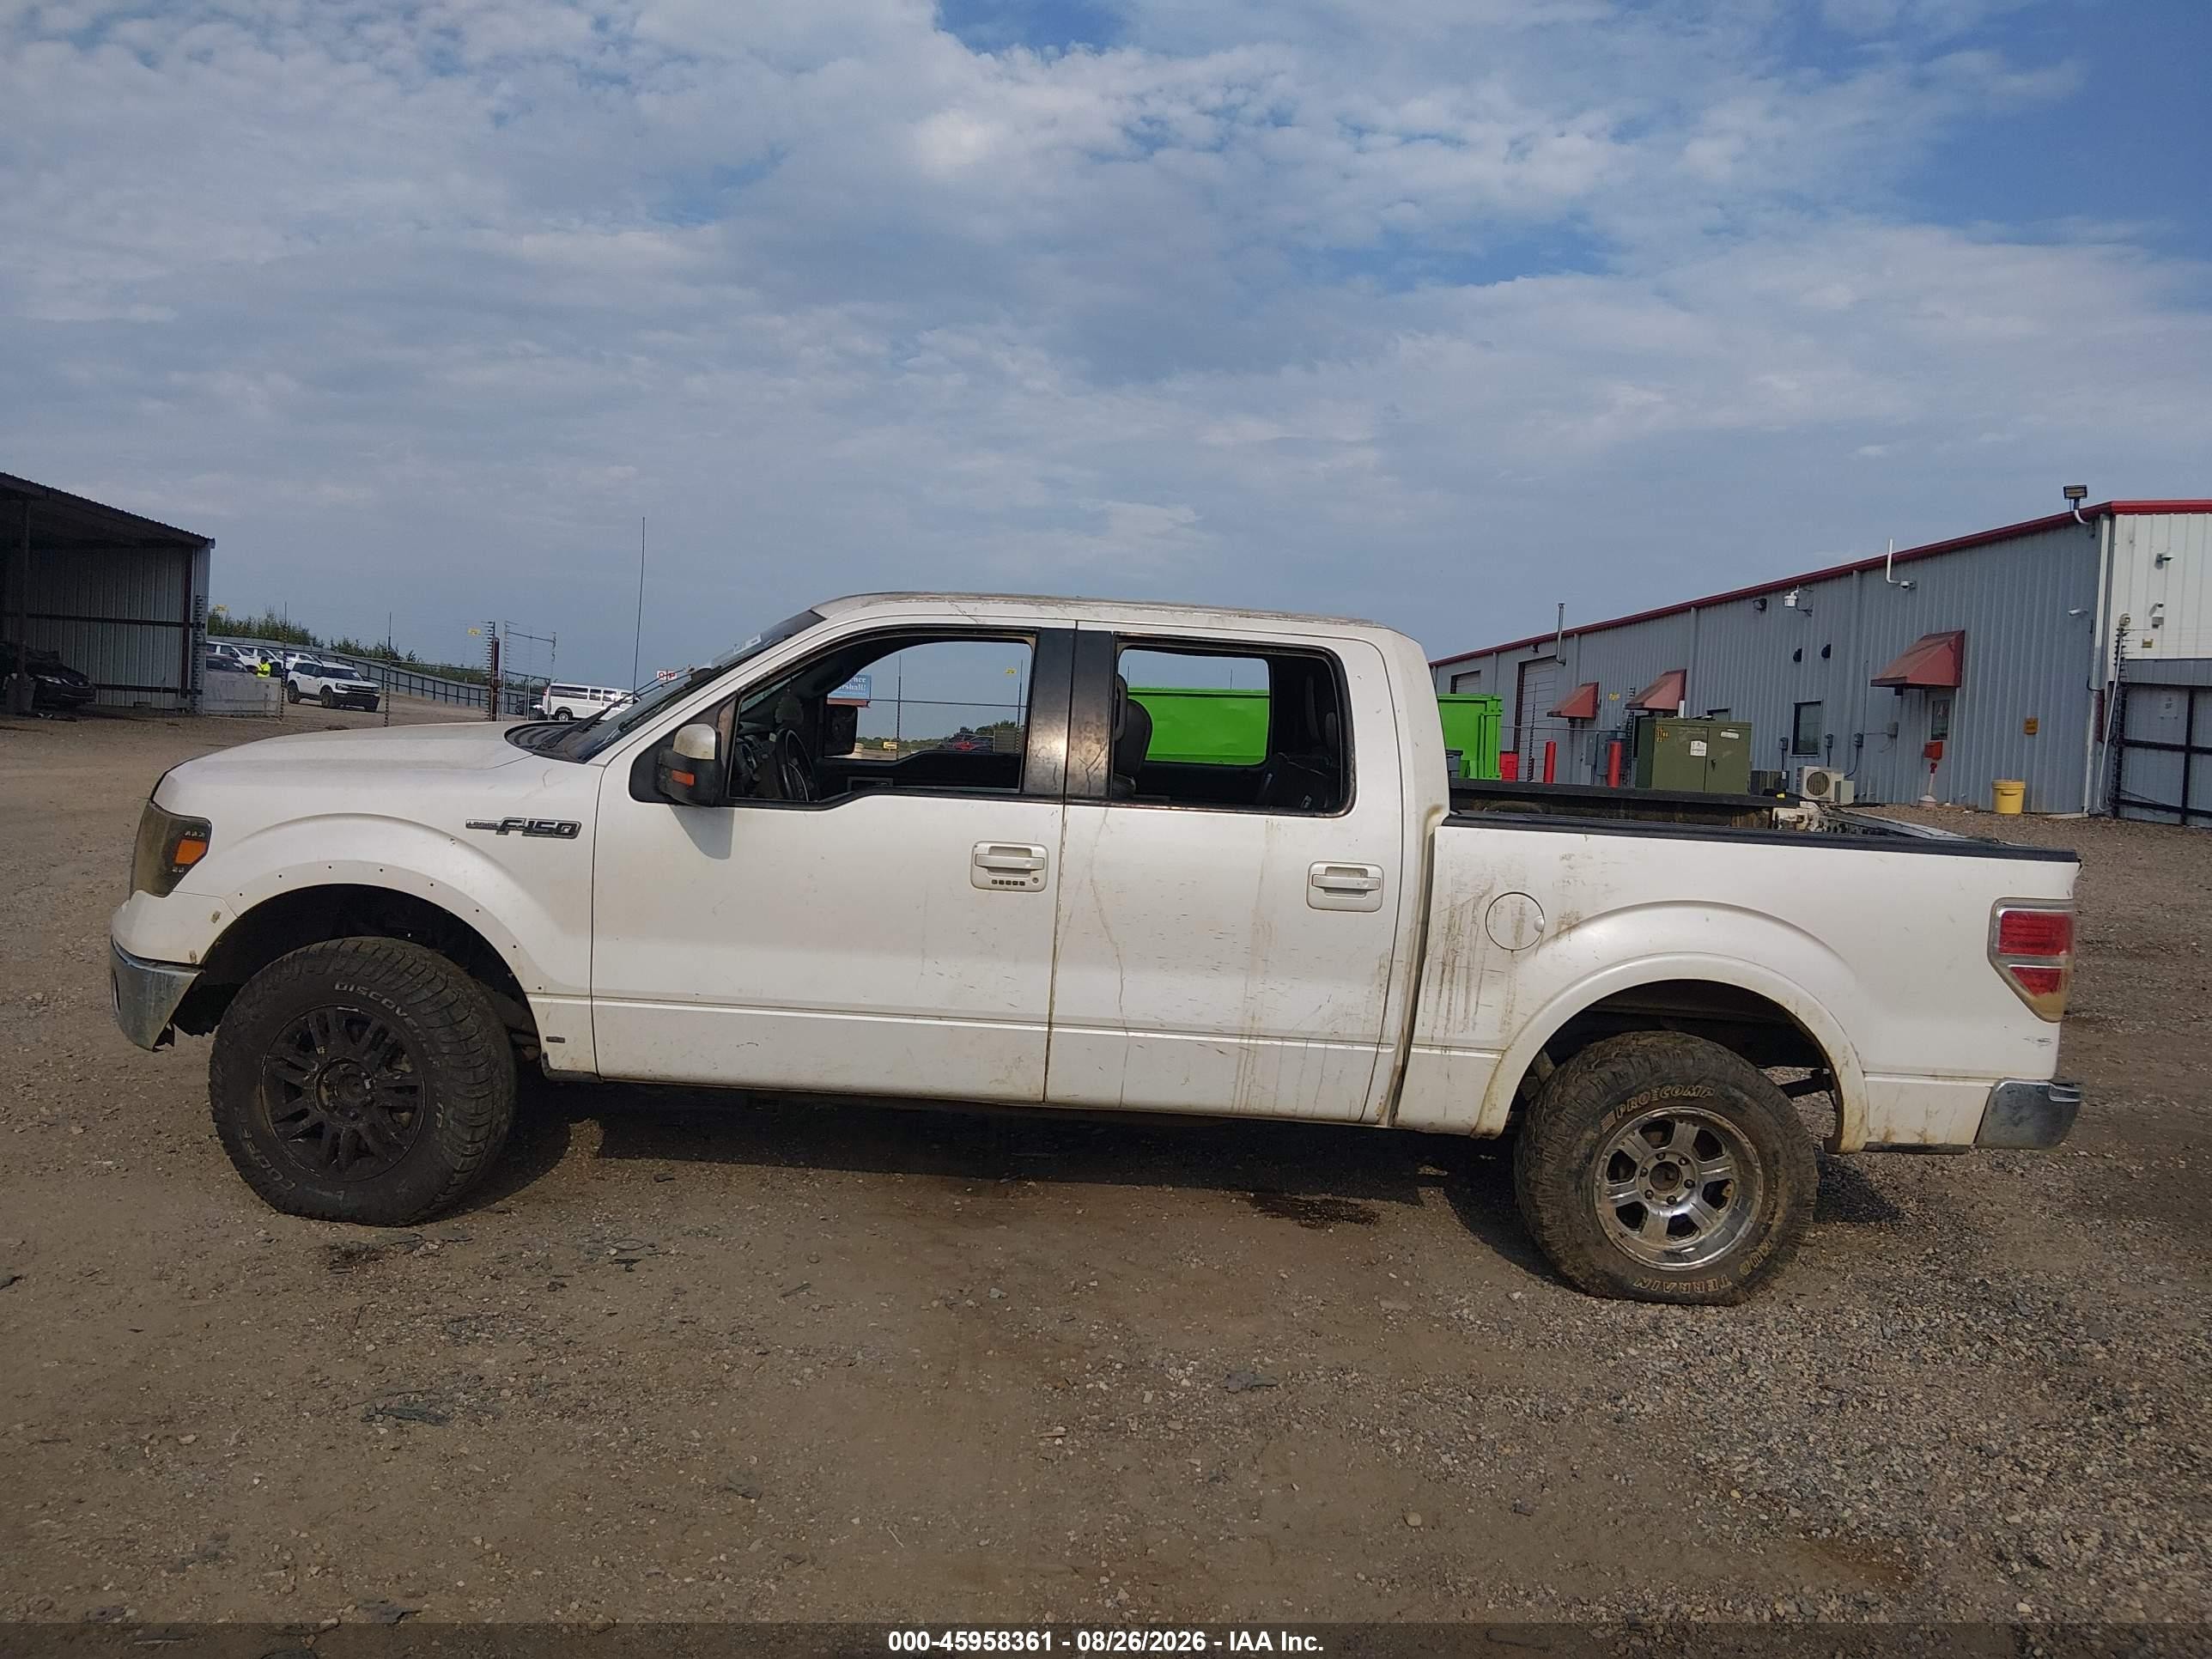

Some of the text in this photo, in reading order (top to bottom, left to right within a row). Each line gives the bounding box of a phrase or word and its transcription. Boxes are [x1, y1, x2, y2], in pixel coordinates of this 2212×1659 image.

[496, 817, 582, 839] F-150
[335, 982, 441, 1068] DISCOVE
[1615, 1091, 1650, 1119] PRO
[1659, 1085, 1716, 1099] COMP
[1632, 1273, 1733, 1294] TERRAIN
